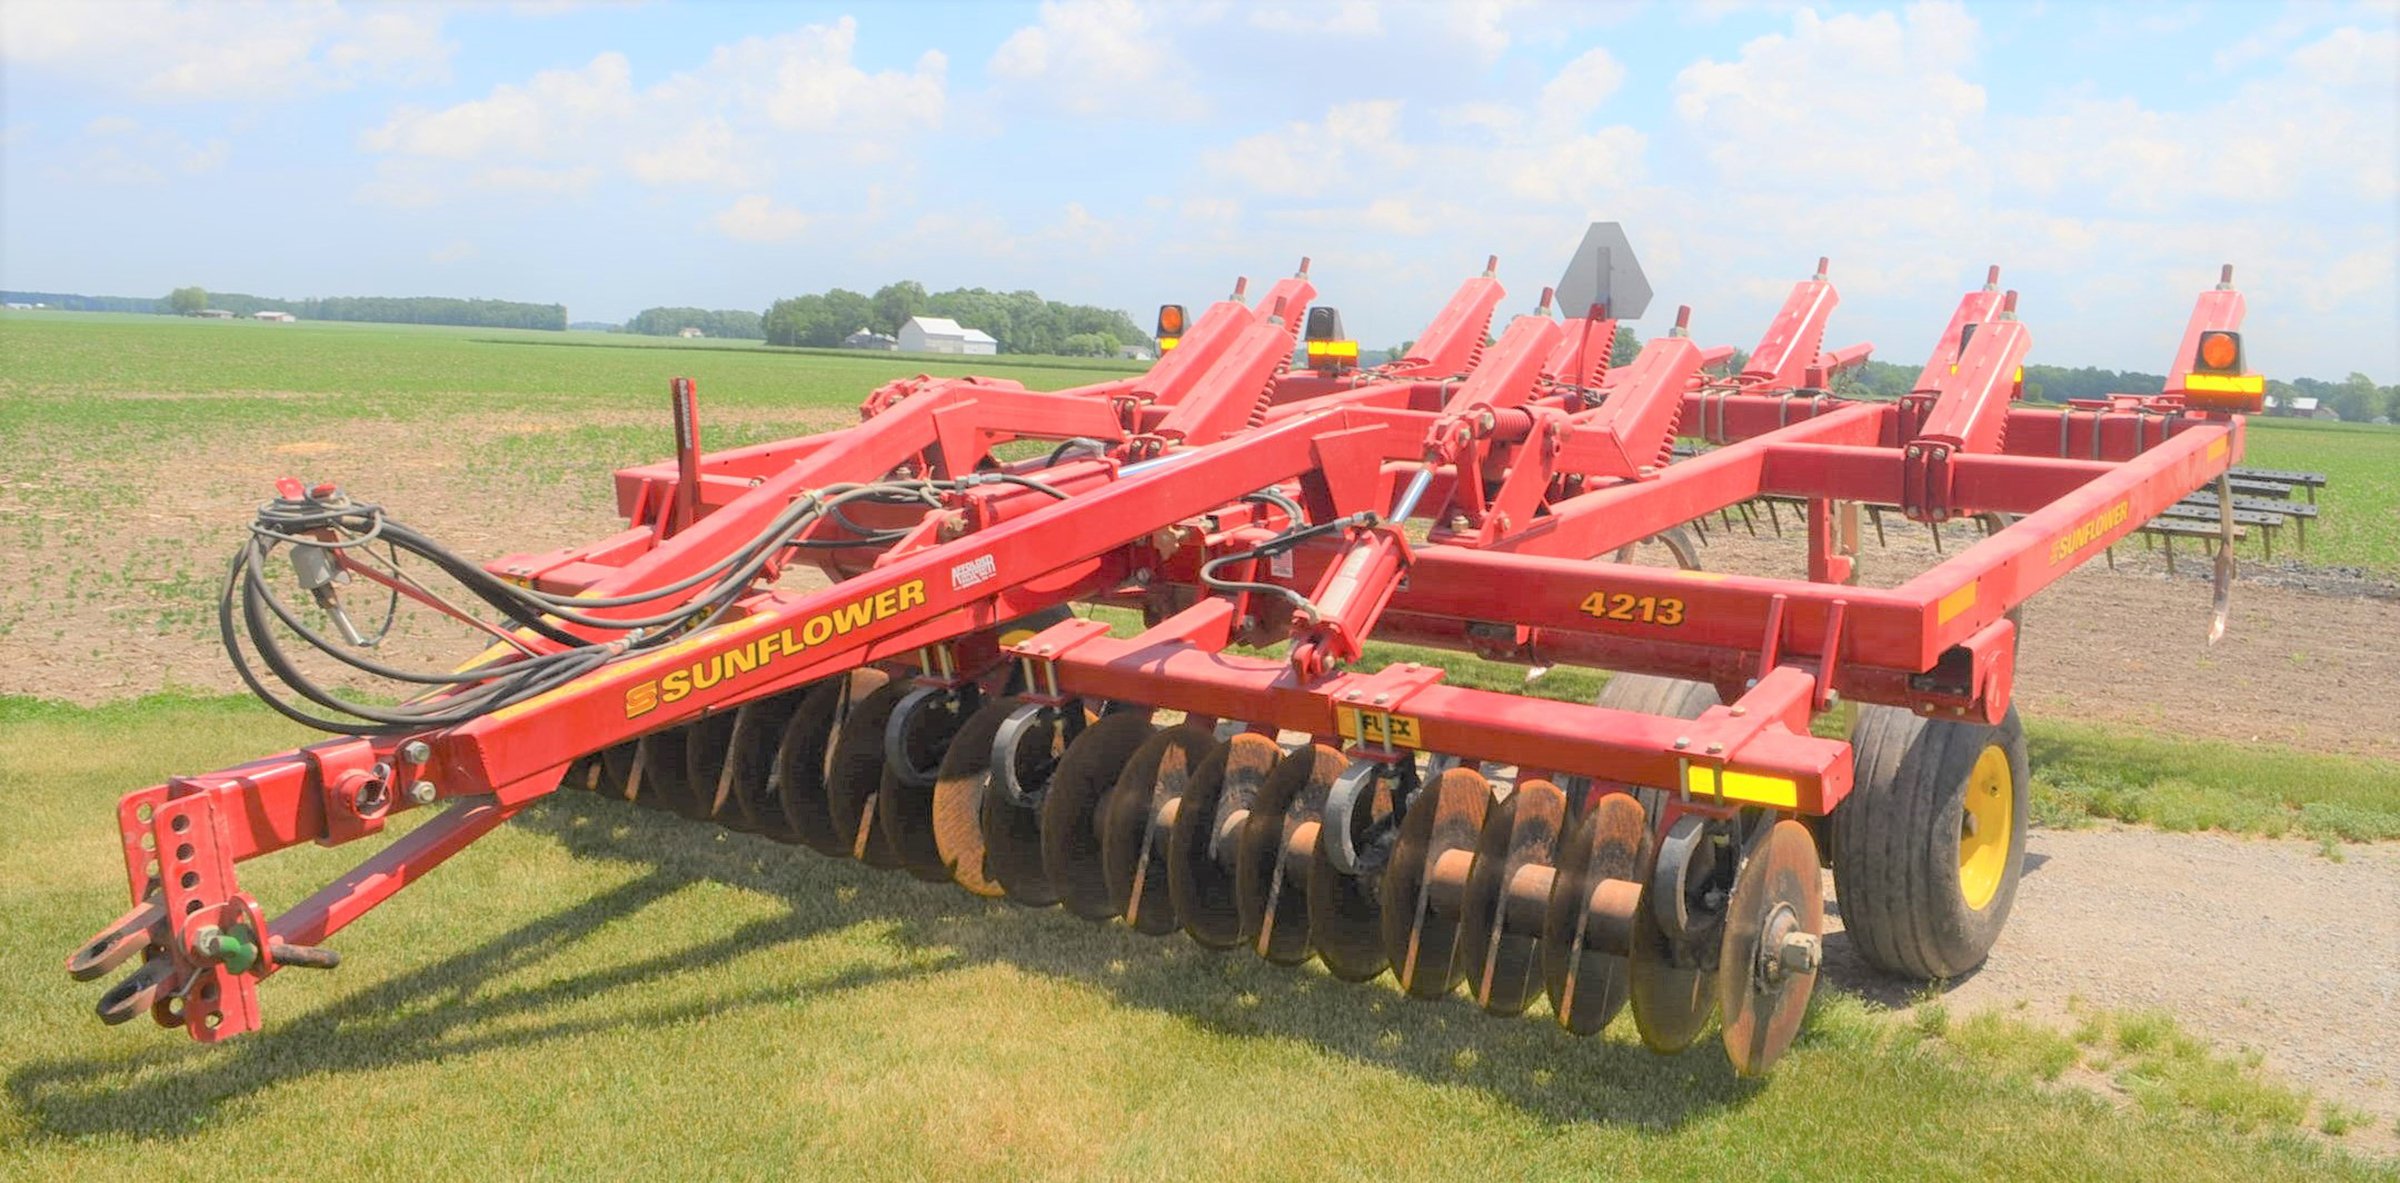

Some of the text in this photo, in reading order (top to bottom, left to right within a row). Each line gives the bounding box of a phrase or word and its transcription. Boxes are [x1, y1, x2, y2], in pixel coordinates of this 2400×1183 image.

[2058, 500, 2128, 561] SUNFLOWER
[1579, 591, 1685, 626] 4213
[660, 579, 926, 702] SUNFLOWER
